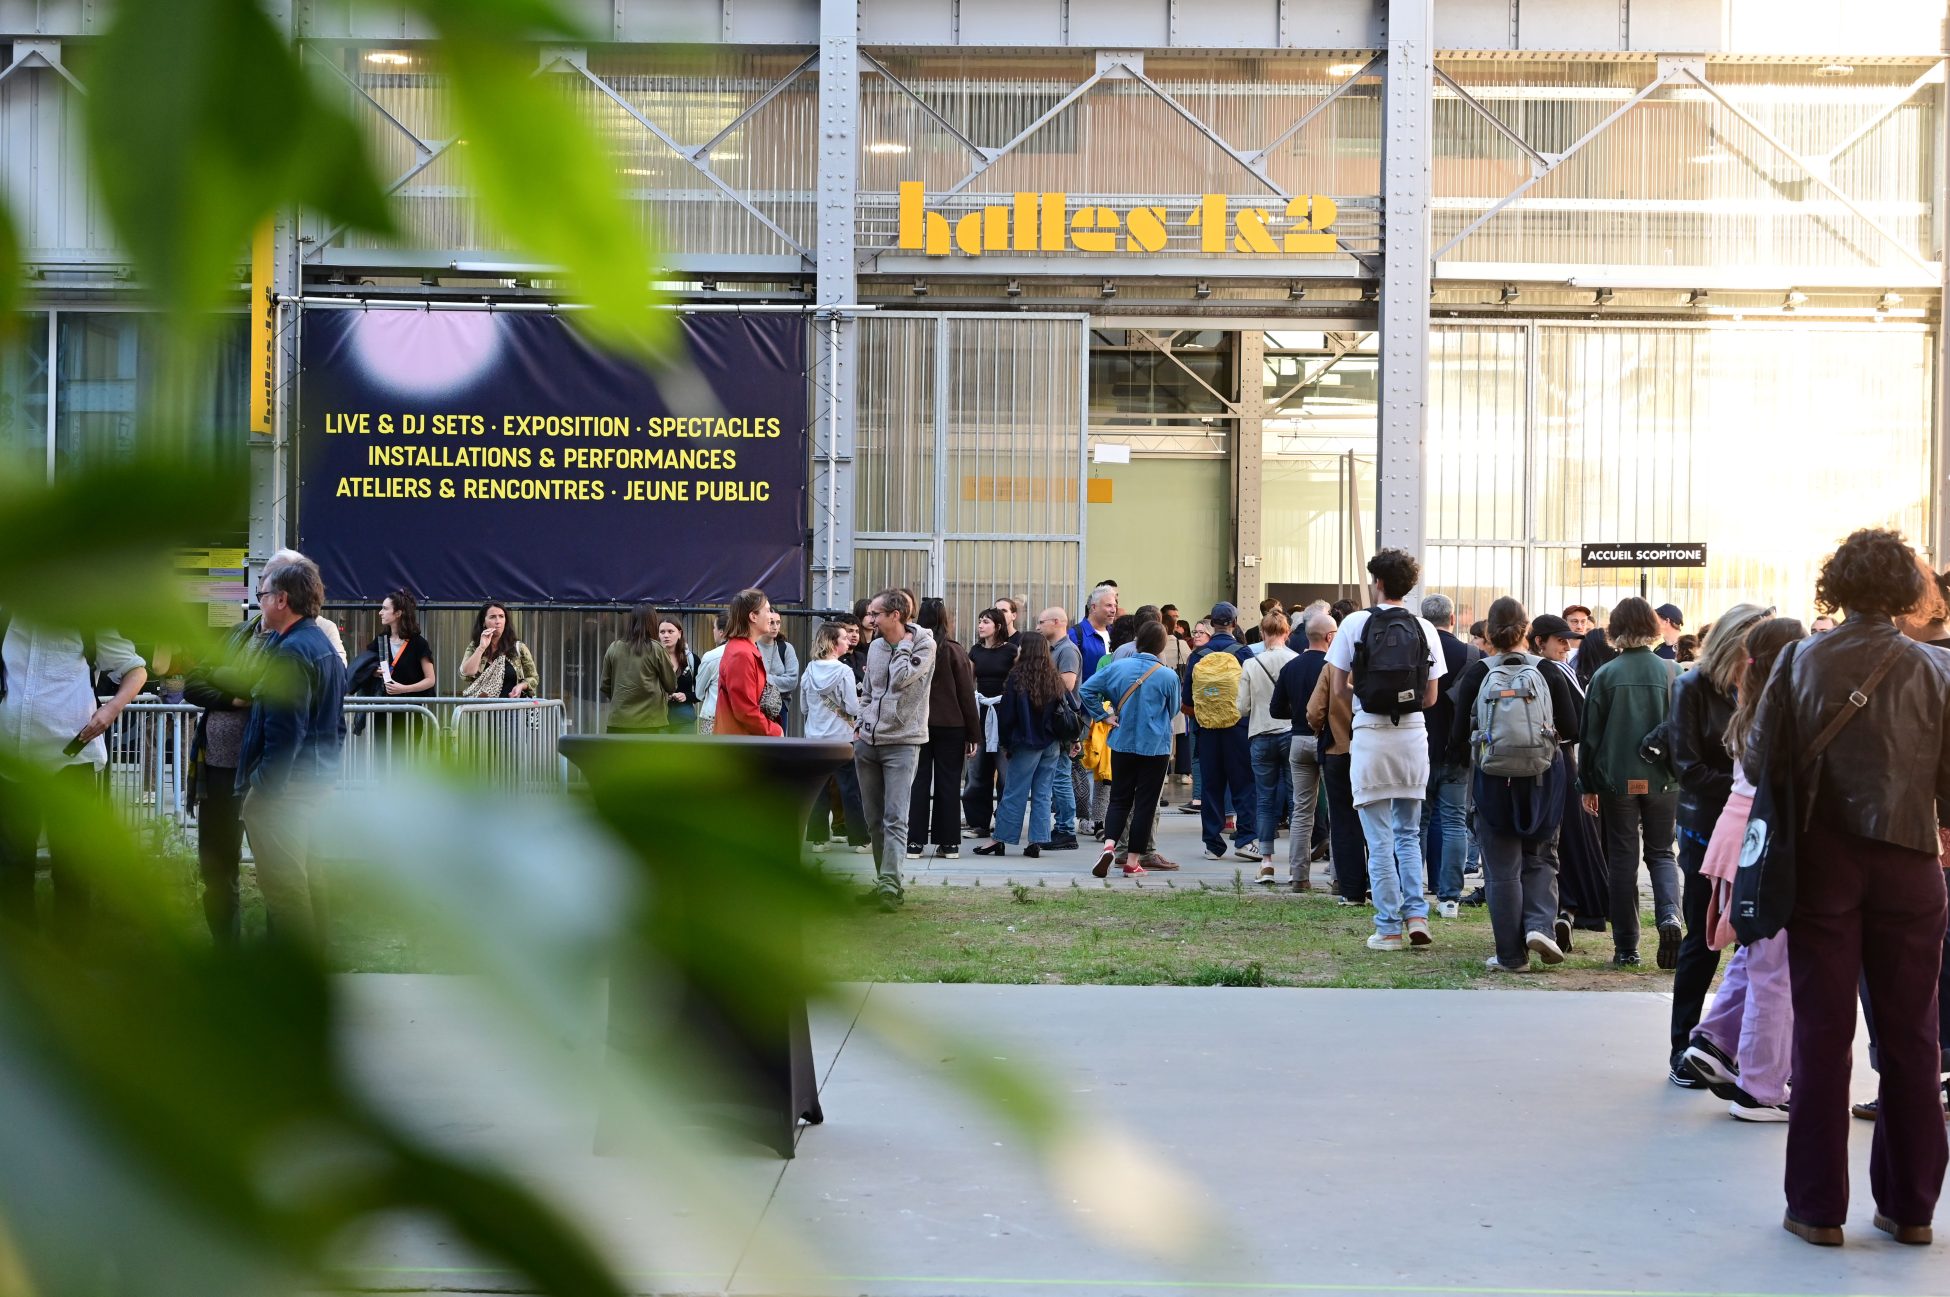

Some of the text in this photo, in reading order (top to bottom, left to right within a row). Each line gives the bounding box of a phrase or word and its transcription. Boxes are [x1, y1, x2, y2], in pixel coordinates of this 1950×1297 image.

[899, 181, 1168, 256] halles
[263, 339, 272, 425] halles
[325, 413, 371, 434] LIVE
[377, 413, 395, 434] &
[402, 414, 425, 435] DJ
[431, 414, 485, 436] SETS
[503, 415, 630, 437] EXPOSITION
[648, 416, 781, 438] SPECTACLES
[368, 445, 737, 470] INSTALLATIONS & PERFORMANCES
[335, 477, 432, 498] ATELIERS
[438, 478, 456, 499] &
[464, 478, 605, 501] RENCONTRES
[623, 480, 689, 501] JEUNE
[695, 480, 770, 502] PUBLIC
[1587, 549, 1702, 560] ACCUEIL SCOPITONE
